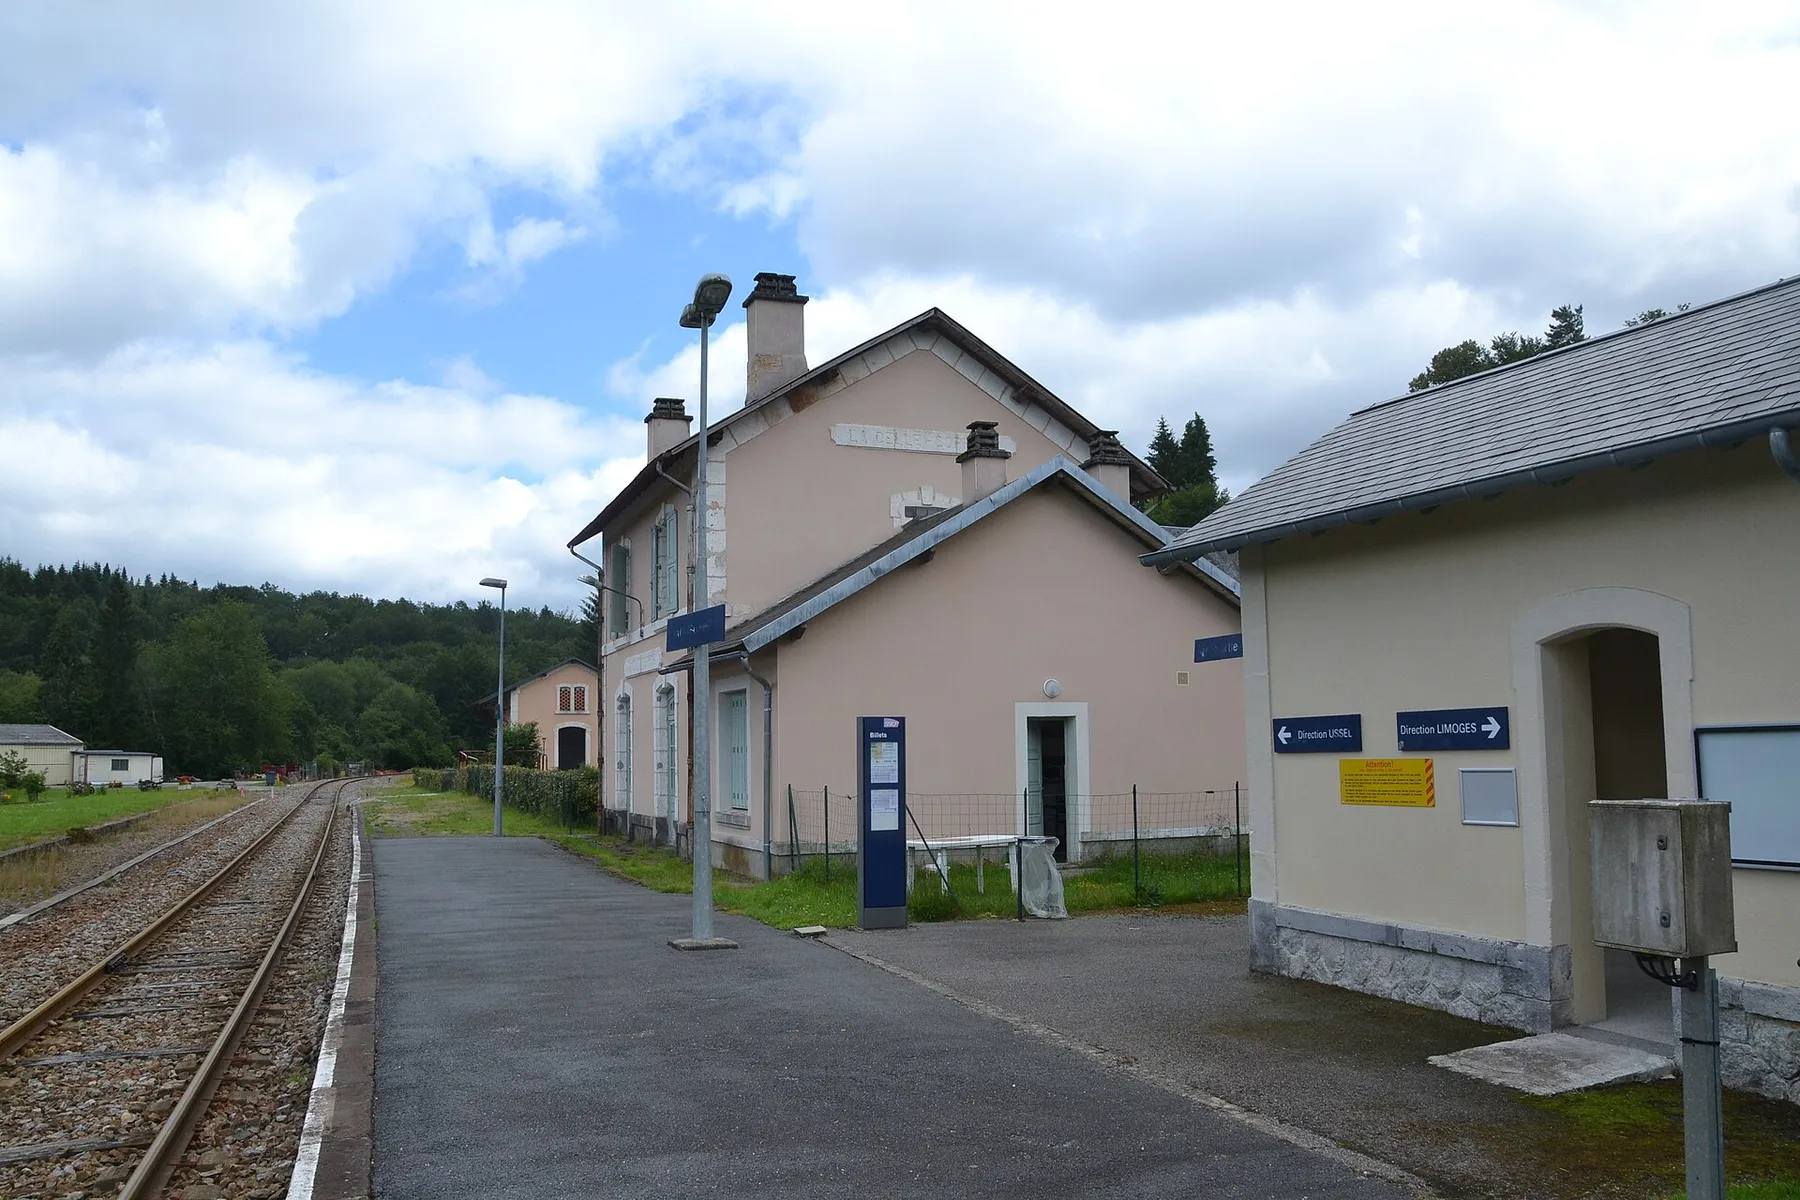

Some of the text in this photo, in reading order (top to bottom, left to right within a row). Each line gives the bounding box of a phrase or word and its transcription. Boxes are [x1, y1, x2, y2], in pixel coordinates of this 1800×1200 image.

[849, 428, 868, 444] LA
[1298, 728, 1352, 739] Direction USSEL
[1400, 722, 1477, 735] Direction LIMOGES
